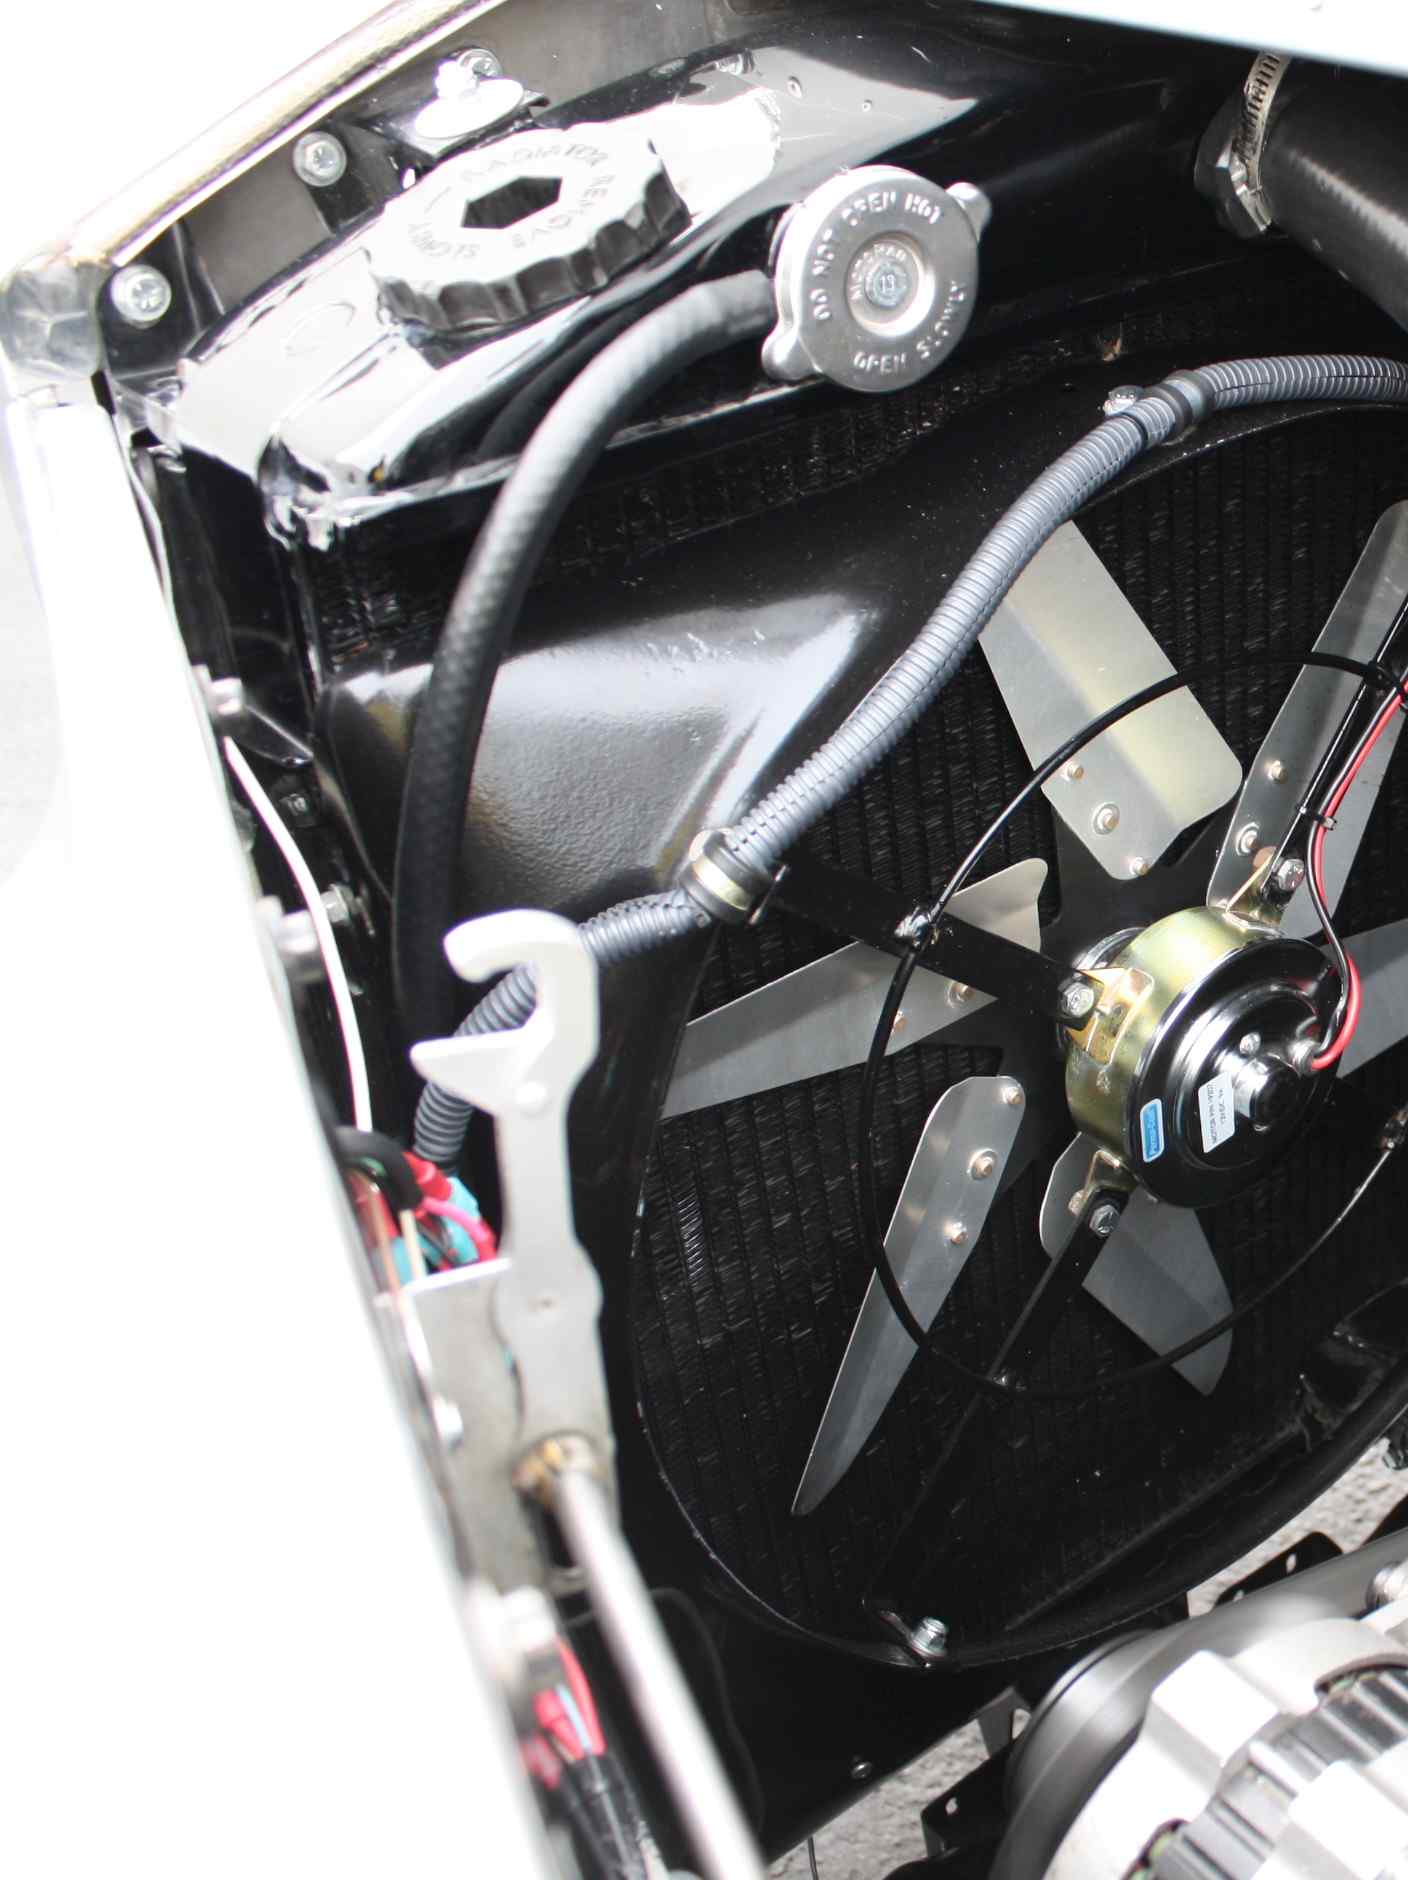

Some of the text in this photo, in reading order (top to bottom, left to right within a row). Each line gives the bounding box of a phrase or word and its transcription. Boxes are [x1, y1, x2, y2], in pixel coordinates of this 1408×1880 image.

[810, 191, 942, 321] DO NOT OPEN HOT
[853, 351, 908, 374] OPEN
